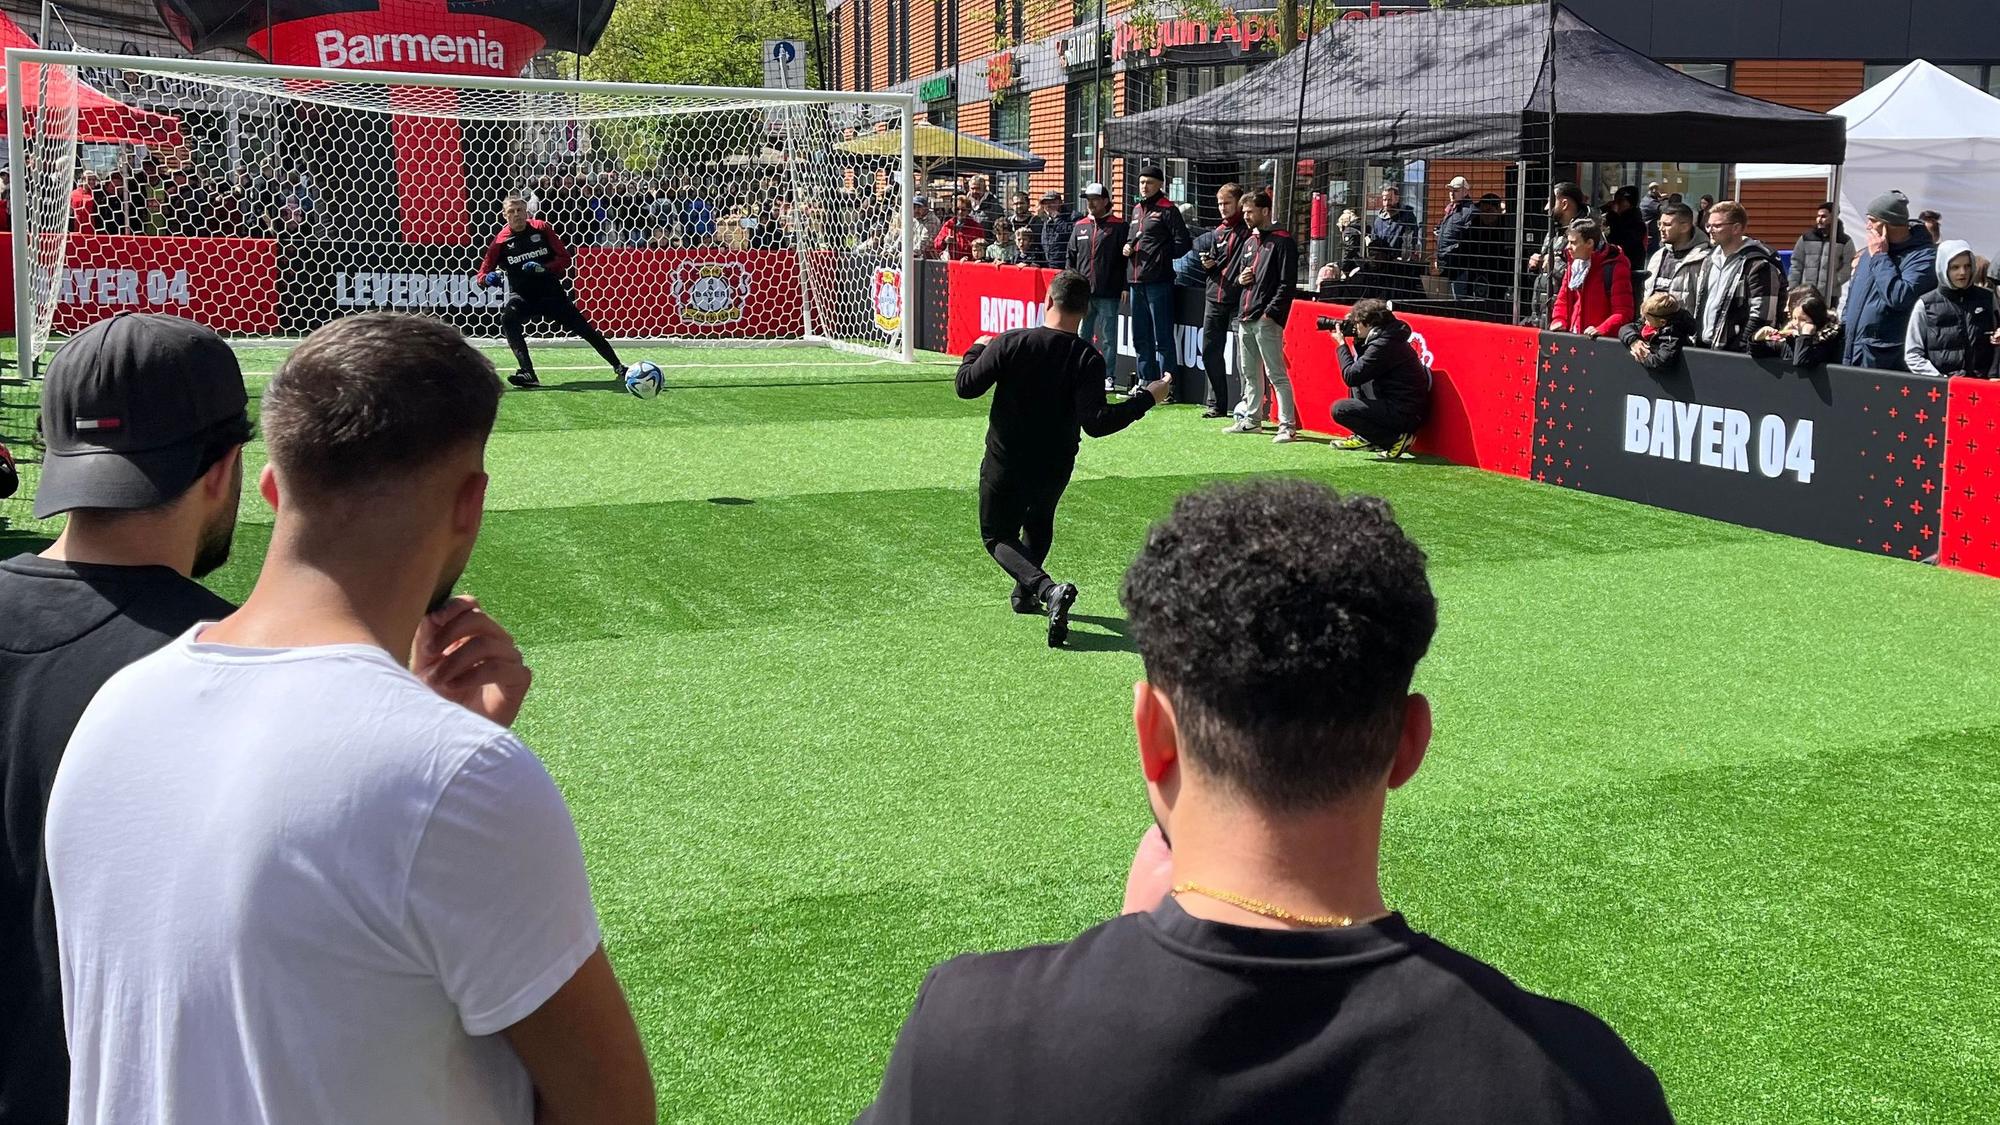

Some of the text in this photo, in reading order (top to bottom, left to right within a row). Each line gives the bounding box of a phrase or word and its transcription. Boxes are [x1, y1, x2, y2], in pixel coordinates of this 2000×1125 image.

[315, 29, 504, 70] Barmenia
[507, 247, 548, 265] Barmenia
[147, 269, 189, 305] 04
[980, 296, 1025, 333] BAYER
[1625, 394, 1815, 484] BAYER 04
